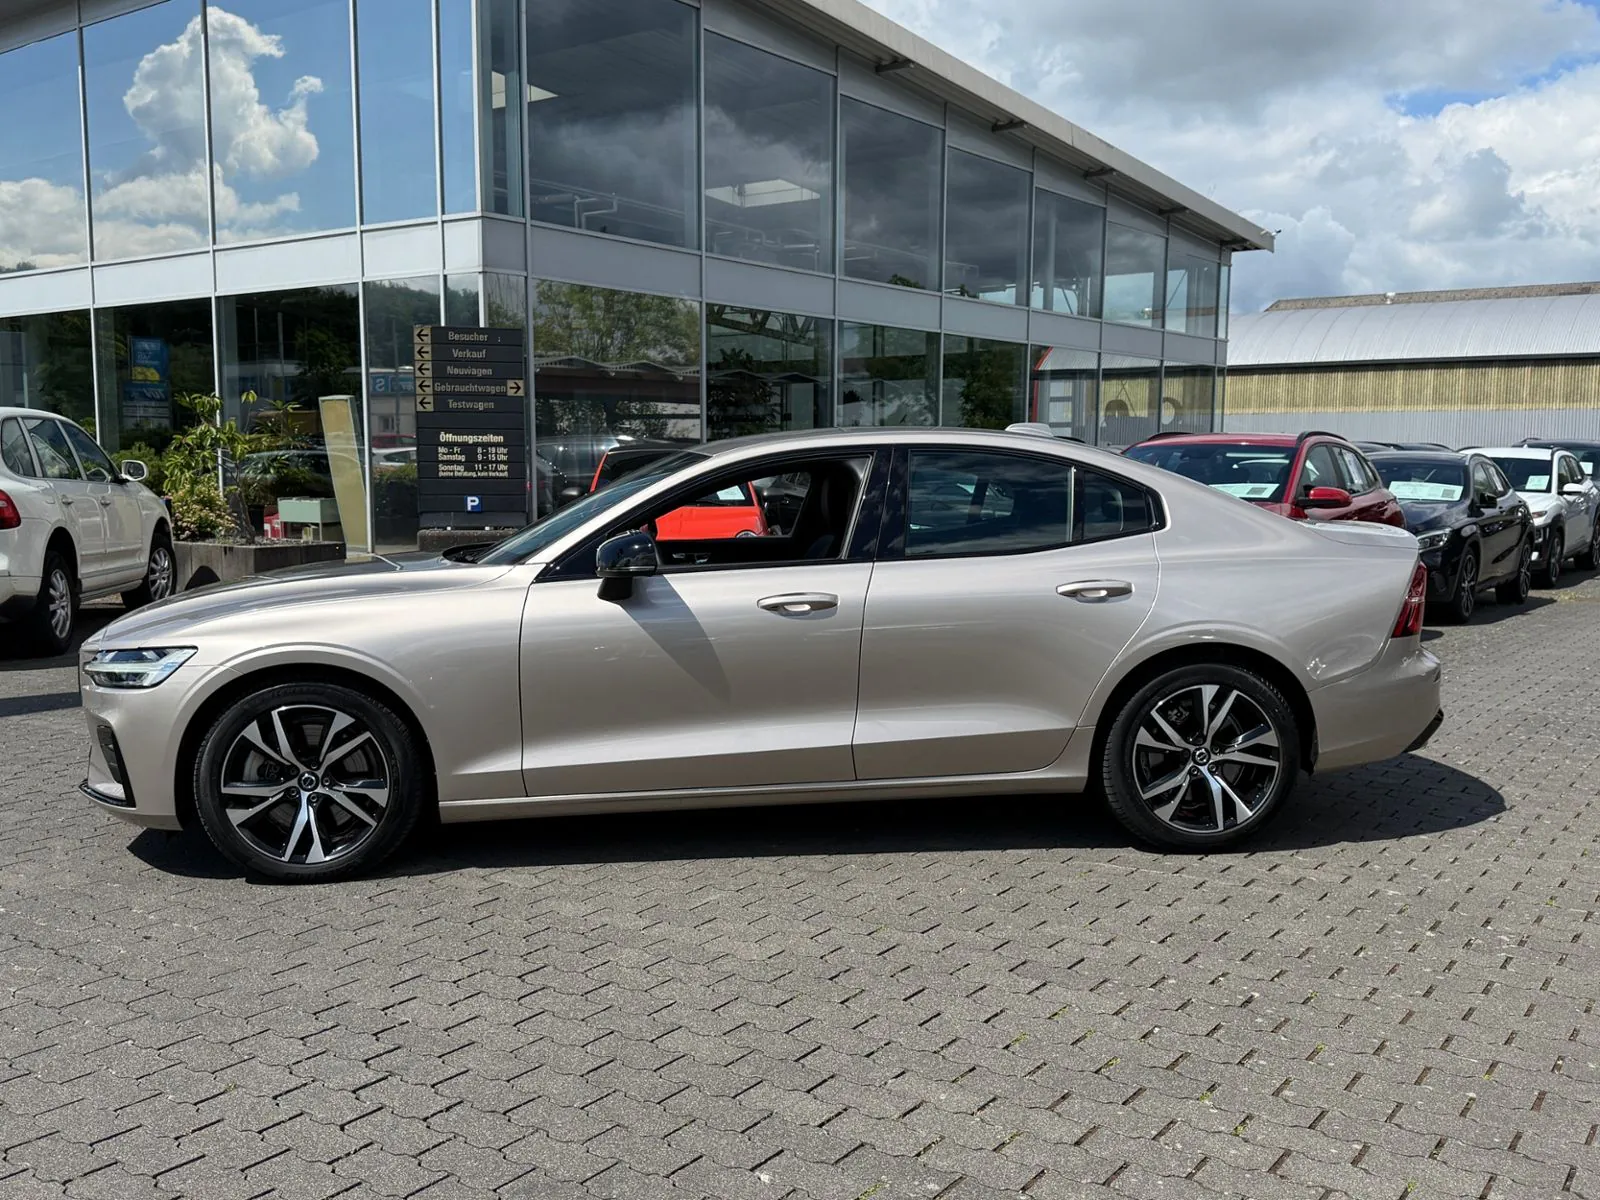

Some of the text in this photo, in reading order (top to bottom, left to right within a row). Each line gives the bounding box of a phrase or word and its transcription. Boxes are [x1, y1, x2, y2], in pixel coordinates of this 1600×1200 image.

[448, 331, 488, 341] Besucher
[452, 349, 487, 358] Verkauf
[446, 366, 493, 376] Neuwagen
[434, 383, 506, 393] Gebrauchtwagen
[447, 399, 495, 410] Testwagen
[440, 432, 503, 443] Öffnungszeiten
[438, 453, 466, 462] Samstag
[477, 453, 482, 461] 9
[488, 453, 496, 461] 15
[496, 453, 508, 461] Uhr
[467, 496, 479, 511] P
